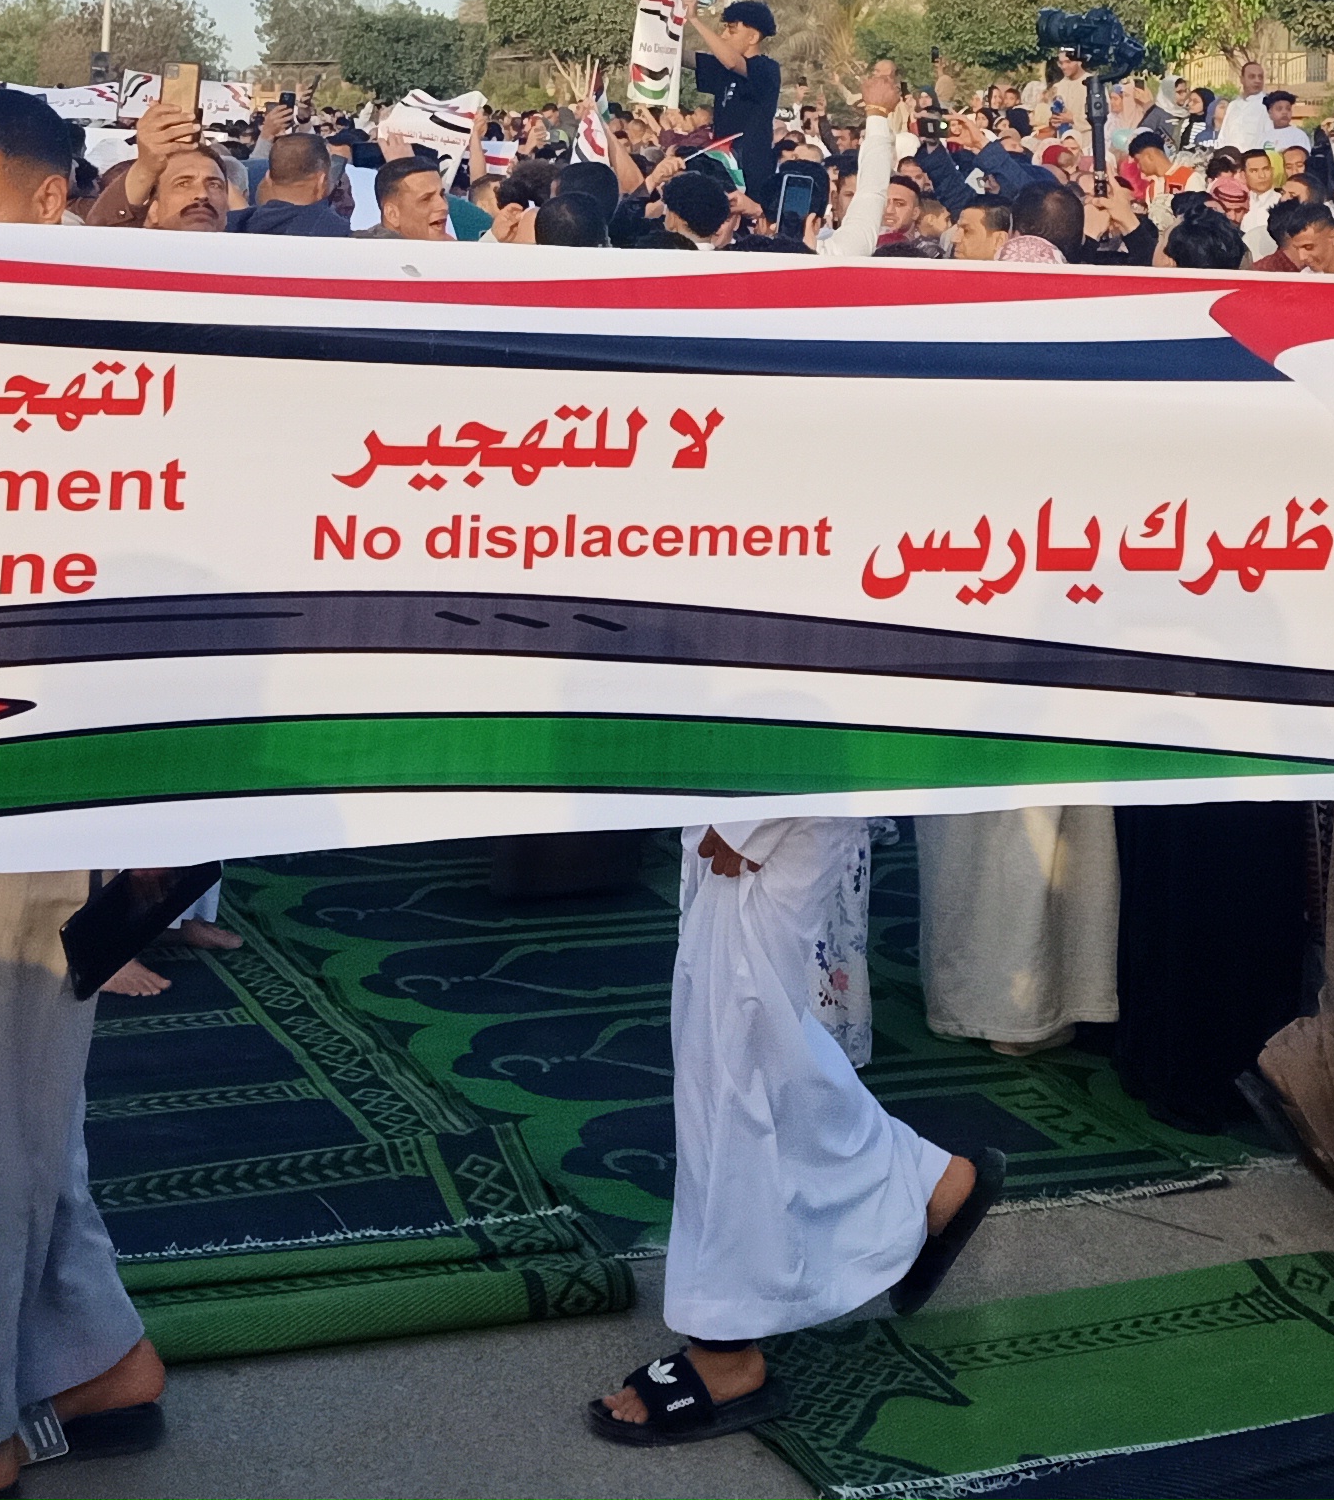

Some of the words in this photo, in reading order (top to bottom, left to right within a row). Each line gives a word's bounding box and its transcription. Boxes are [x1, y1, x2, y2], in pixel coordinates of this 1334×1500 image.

[332, 404, 649, 492] للتهجير
[669, 406, 725, 470] لا
[313, 514, 403, 561] No
[424, 513, 834, 570] displacement
[666, 1396, 695, 1412] adidas
